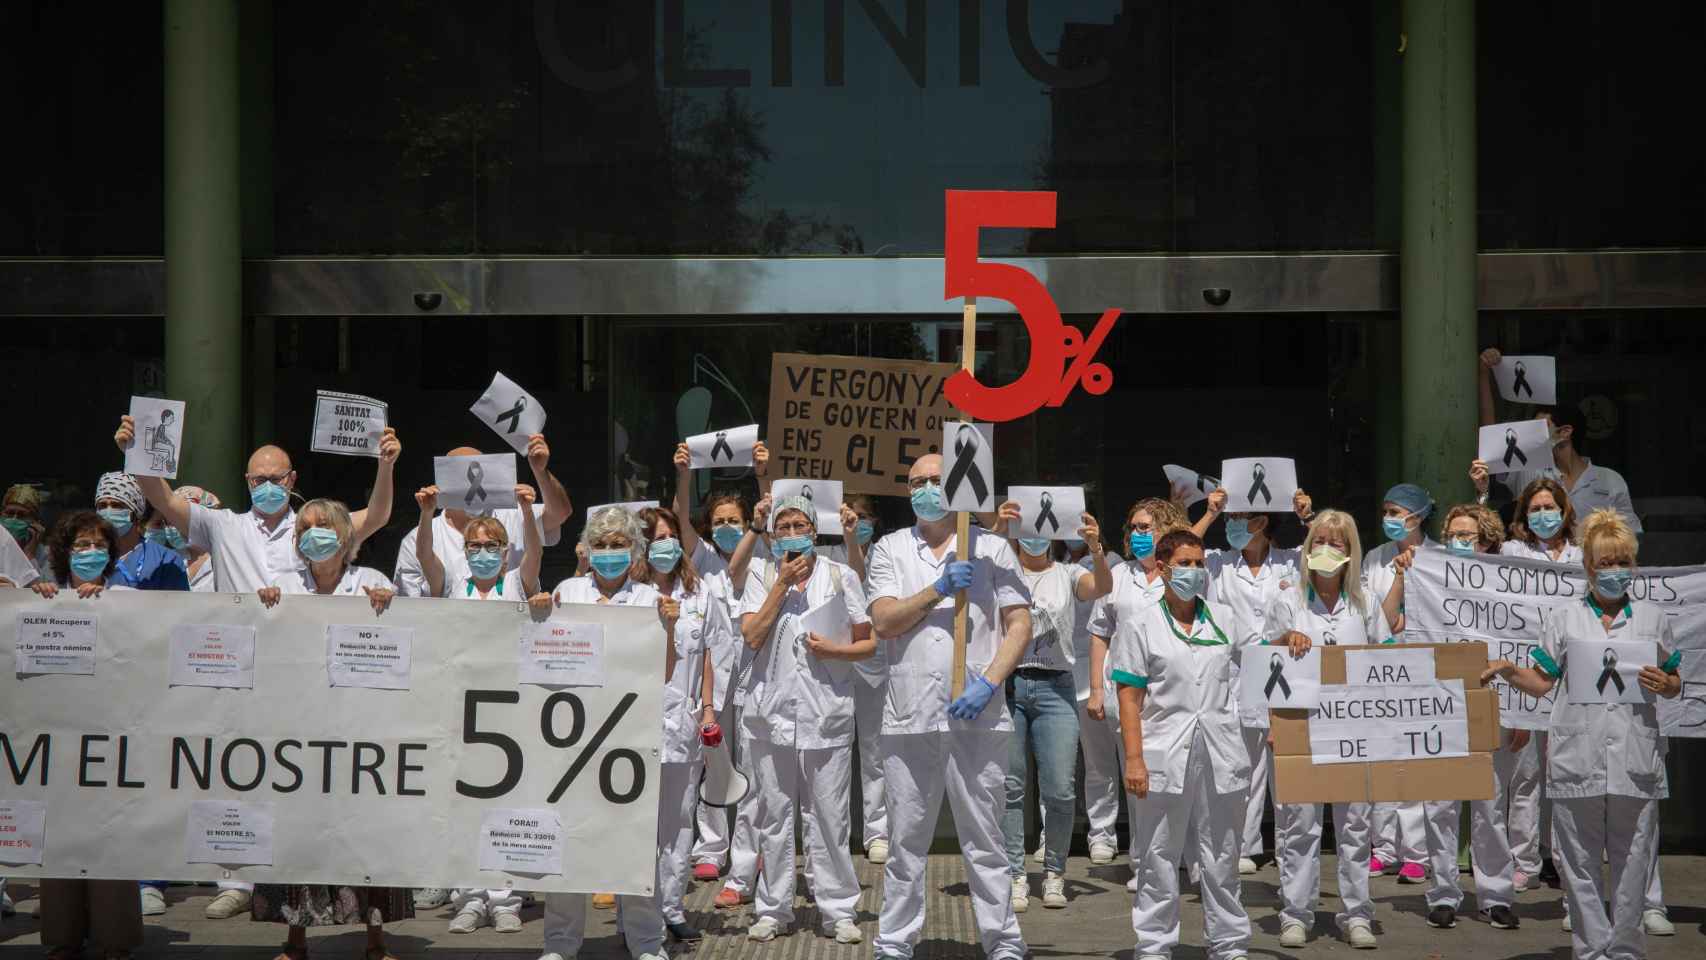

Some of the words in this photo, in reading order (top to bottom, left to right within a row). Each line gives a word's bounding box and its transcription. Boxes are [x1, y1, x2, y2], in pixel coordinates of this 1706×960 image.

[944, 190, 1122, 421] 5%
[334, 404, 371, 418] SANITAT
[785, 400, 811, 420] DE
[823, 403, 917, 431] GOVERN
[338, 419, 366, 433] 100%
[329, 432, 369, 448] PÚBLICA
[784, 427, 822, 452] ENS
[778, 455, 833, 479] TREU
[895, 437, 938, 484] 5
[1444, 561, 1485, 589] NO
[1496, 566, 1575, 597] SOMOS
[1443, 598, 1526, 631] SOMOS
[551, 628, 566, 637] NO
[1366, 665, 1411, 683] ARA
[1317, 696, 1454, 720] NECESSITEM
[78, 734, 145, 788] EL
[170, 736, 428, 796] NOSTRE
[455, 690, 646, 804] 5%
[1339, 738, 1368, 758] DE
[1403, 724, 1443, 756] TÚ
[509, 819, 539, 827] FORA!!!
